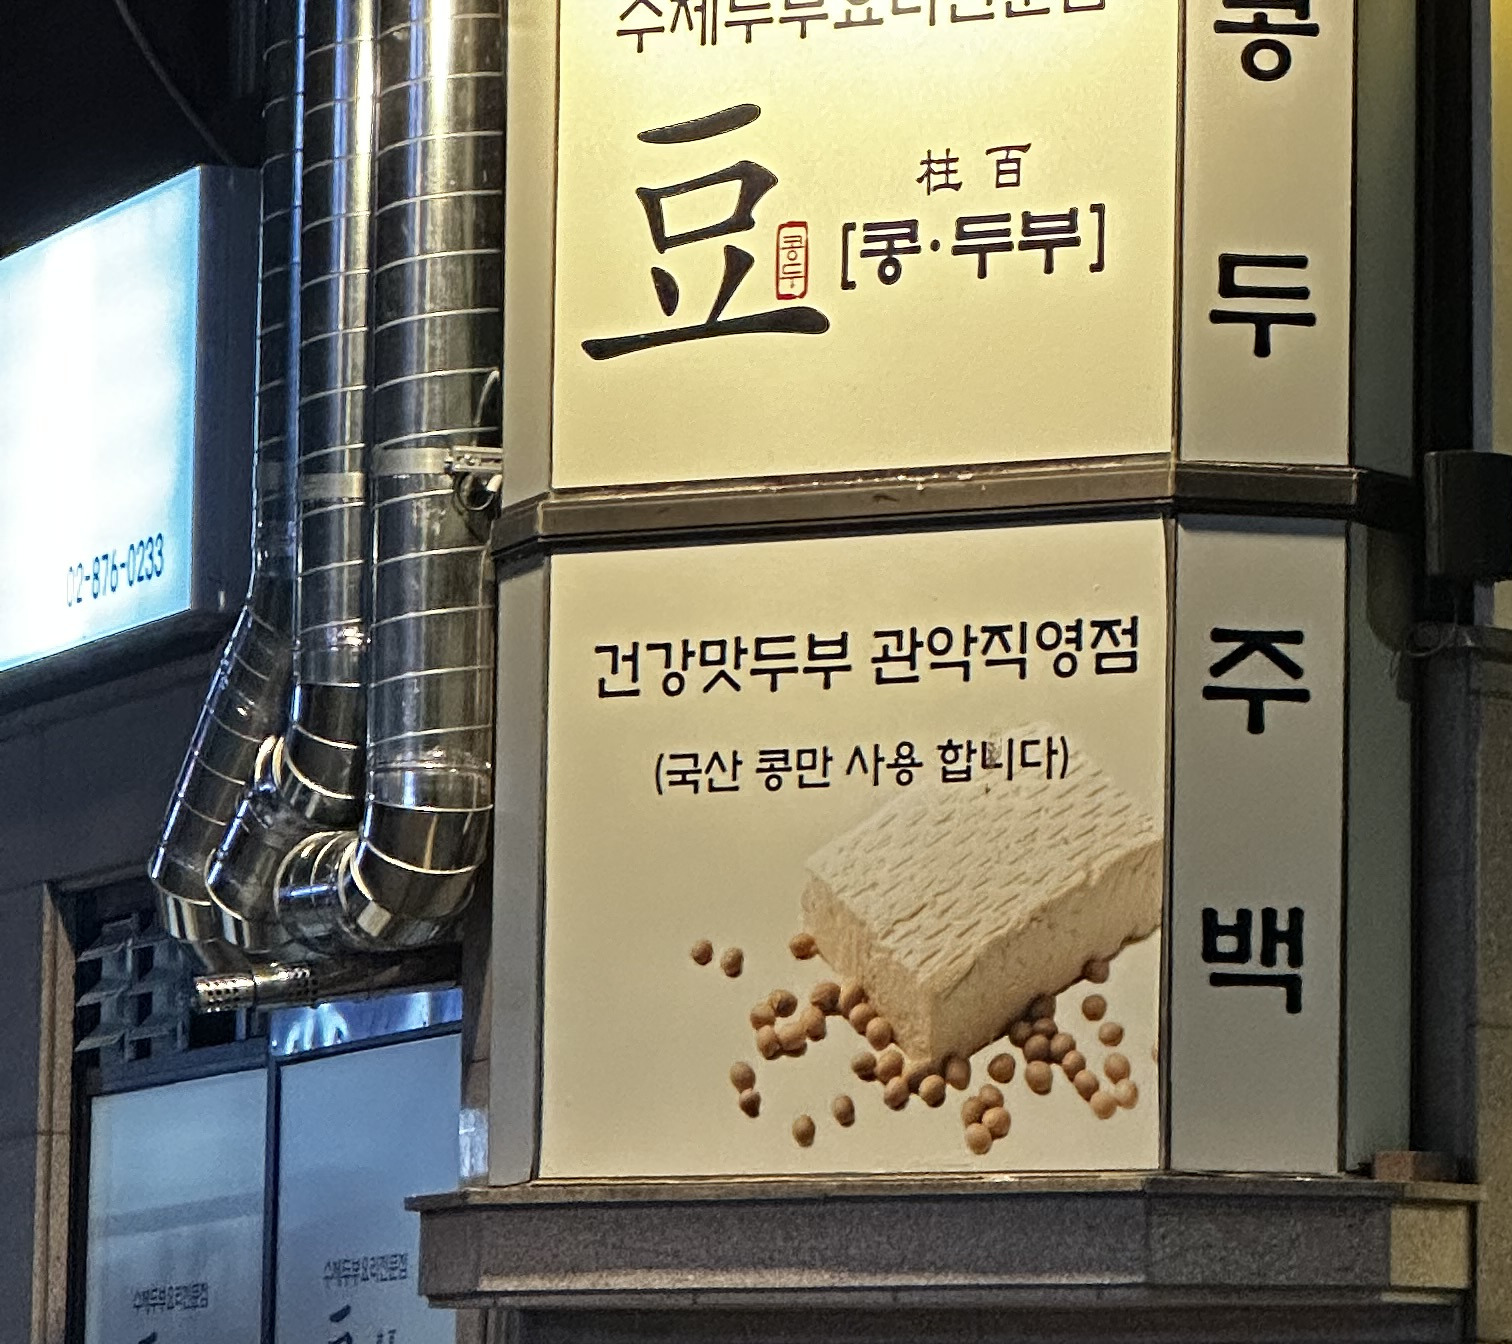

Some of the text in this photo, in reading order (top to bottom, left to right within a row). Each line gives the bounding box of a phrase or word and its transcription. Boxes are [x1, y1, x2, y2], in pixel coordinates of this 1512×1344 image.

[580, 103, 830, 361] 豆
[66, 532, 164, 607] 02-876-0233
[594, 616, 1138, 698] 건강맛두부 관악직영점
[755, 745, 833, 792] 콩만
[845, 740, 924, 787] 사용
